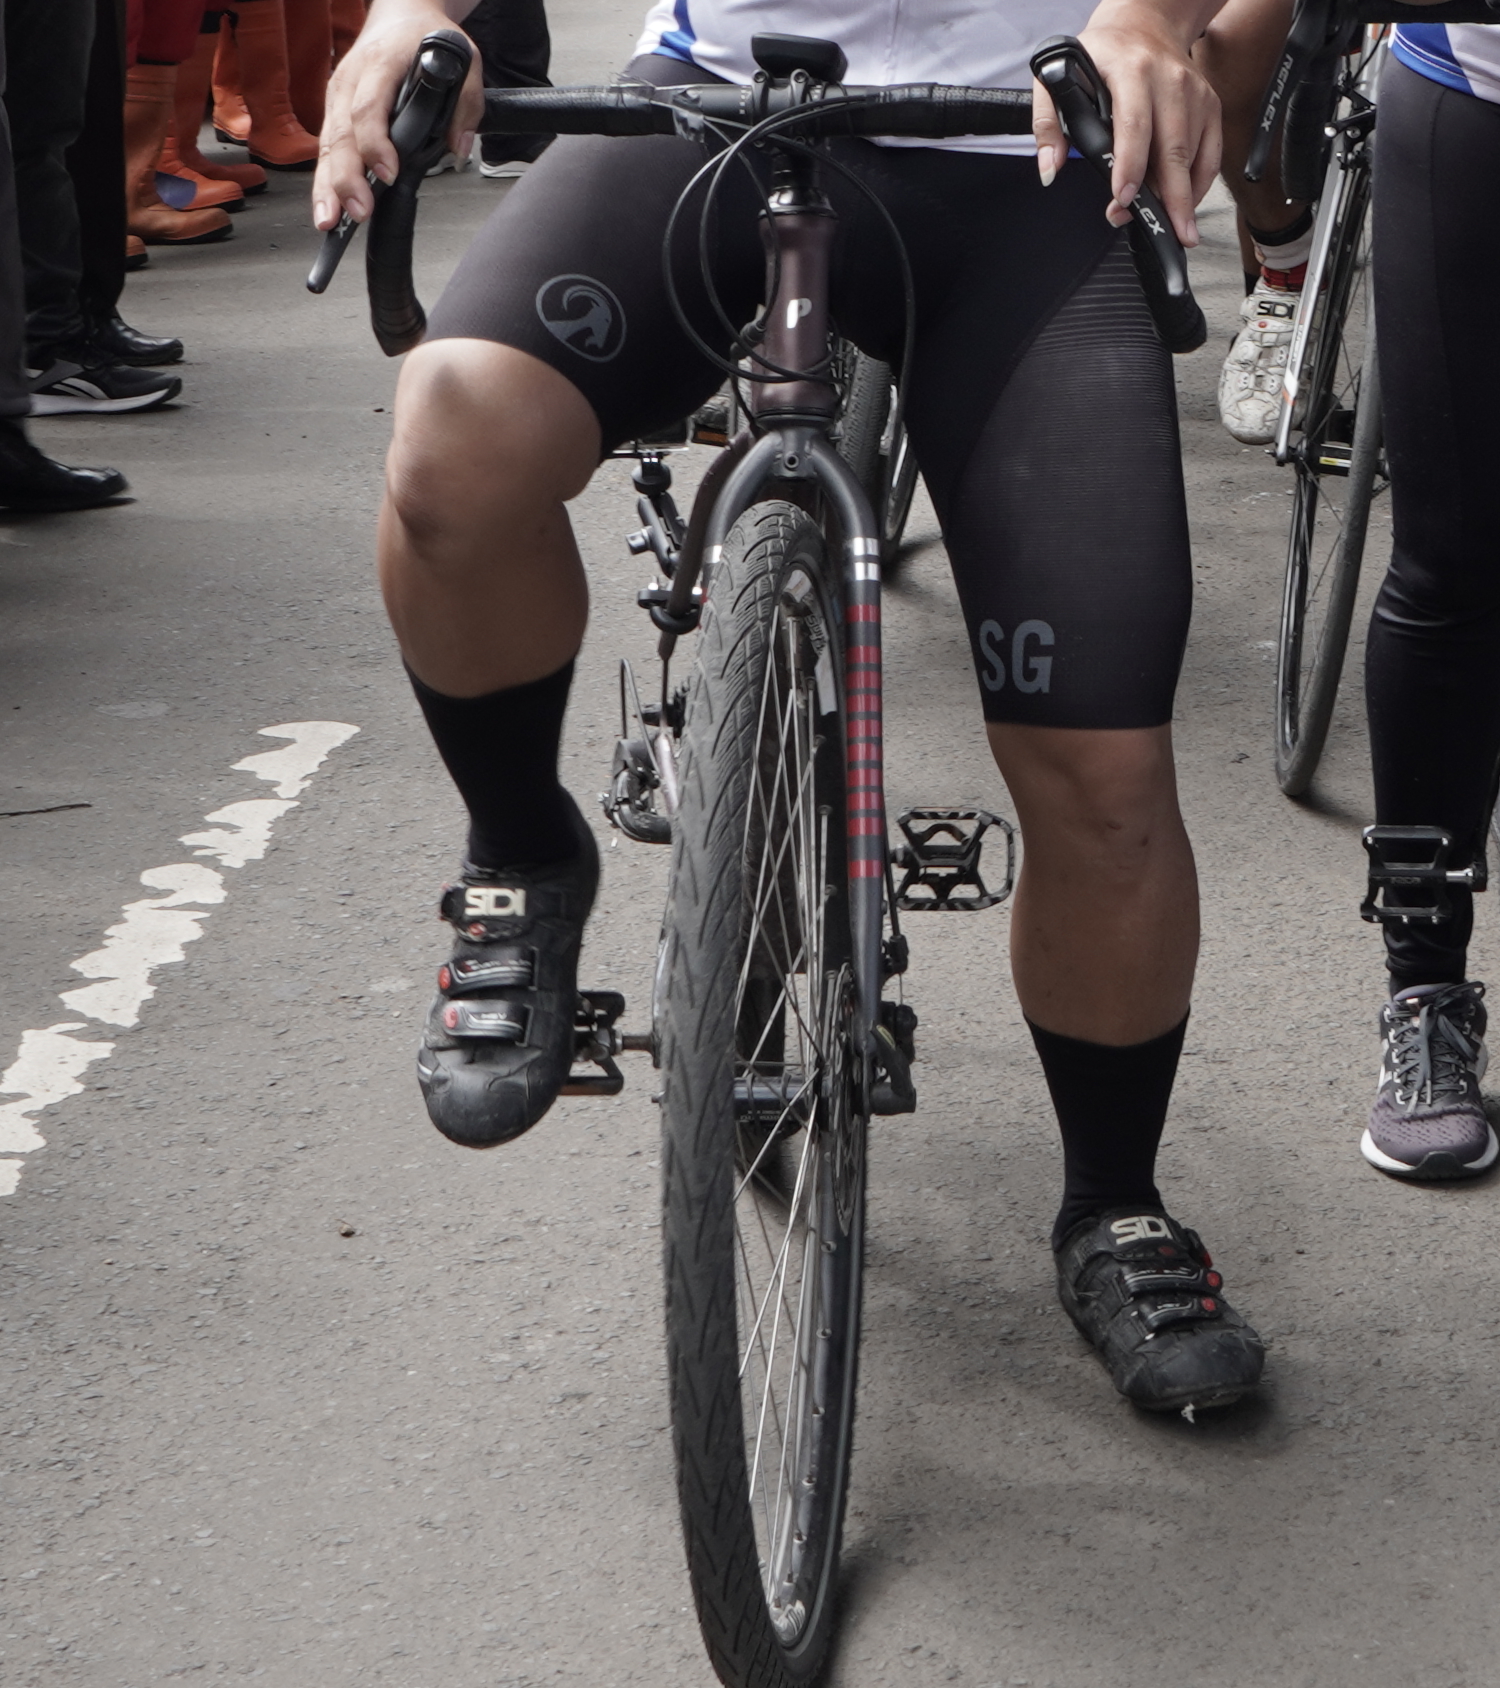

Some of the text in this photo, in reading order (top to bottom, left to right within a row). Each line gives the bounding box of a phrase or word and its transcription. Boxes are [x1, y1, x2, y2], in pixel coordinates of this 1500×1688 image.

[1261, 53, 1293, 132] REFLEX
[979, 619, 1055, 694] SG
[465, 887, 526, 916] SIDI
[1110, 1215, 1172, 1245] SIDI
